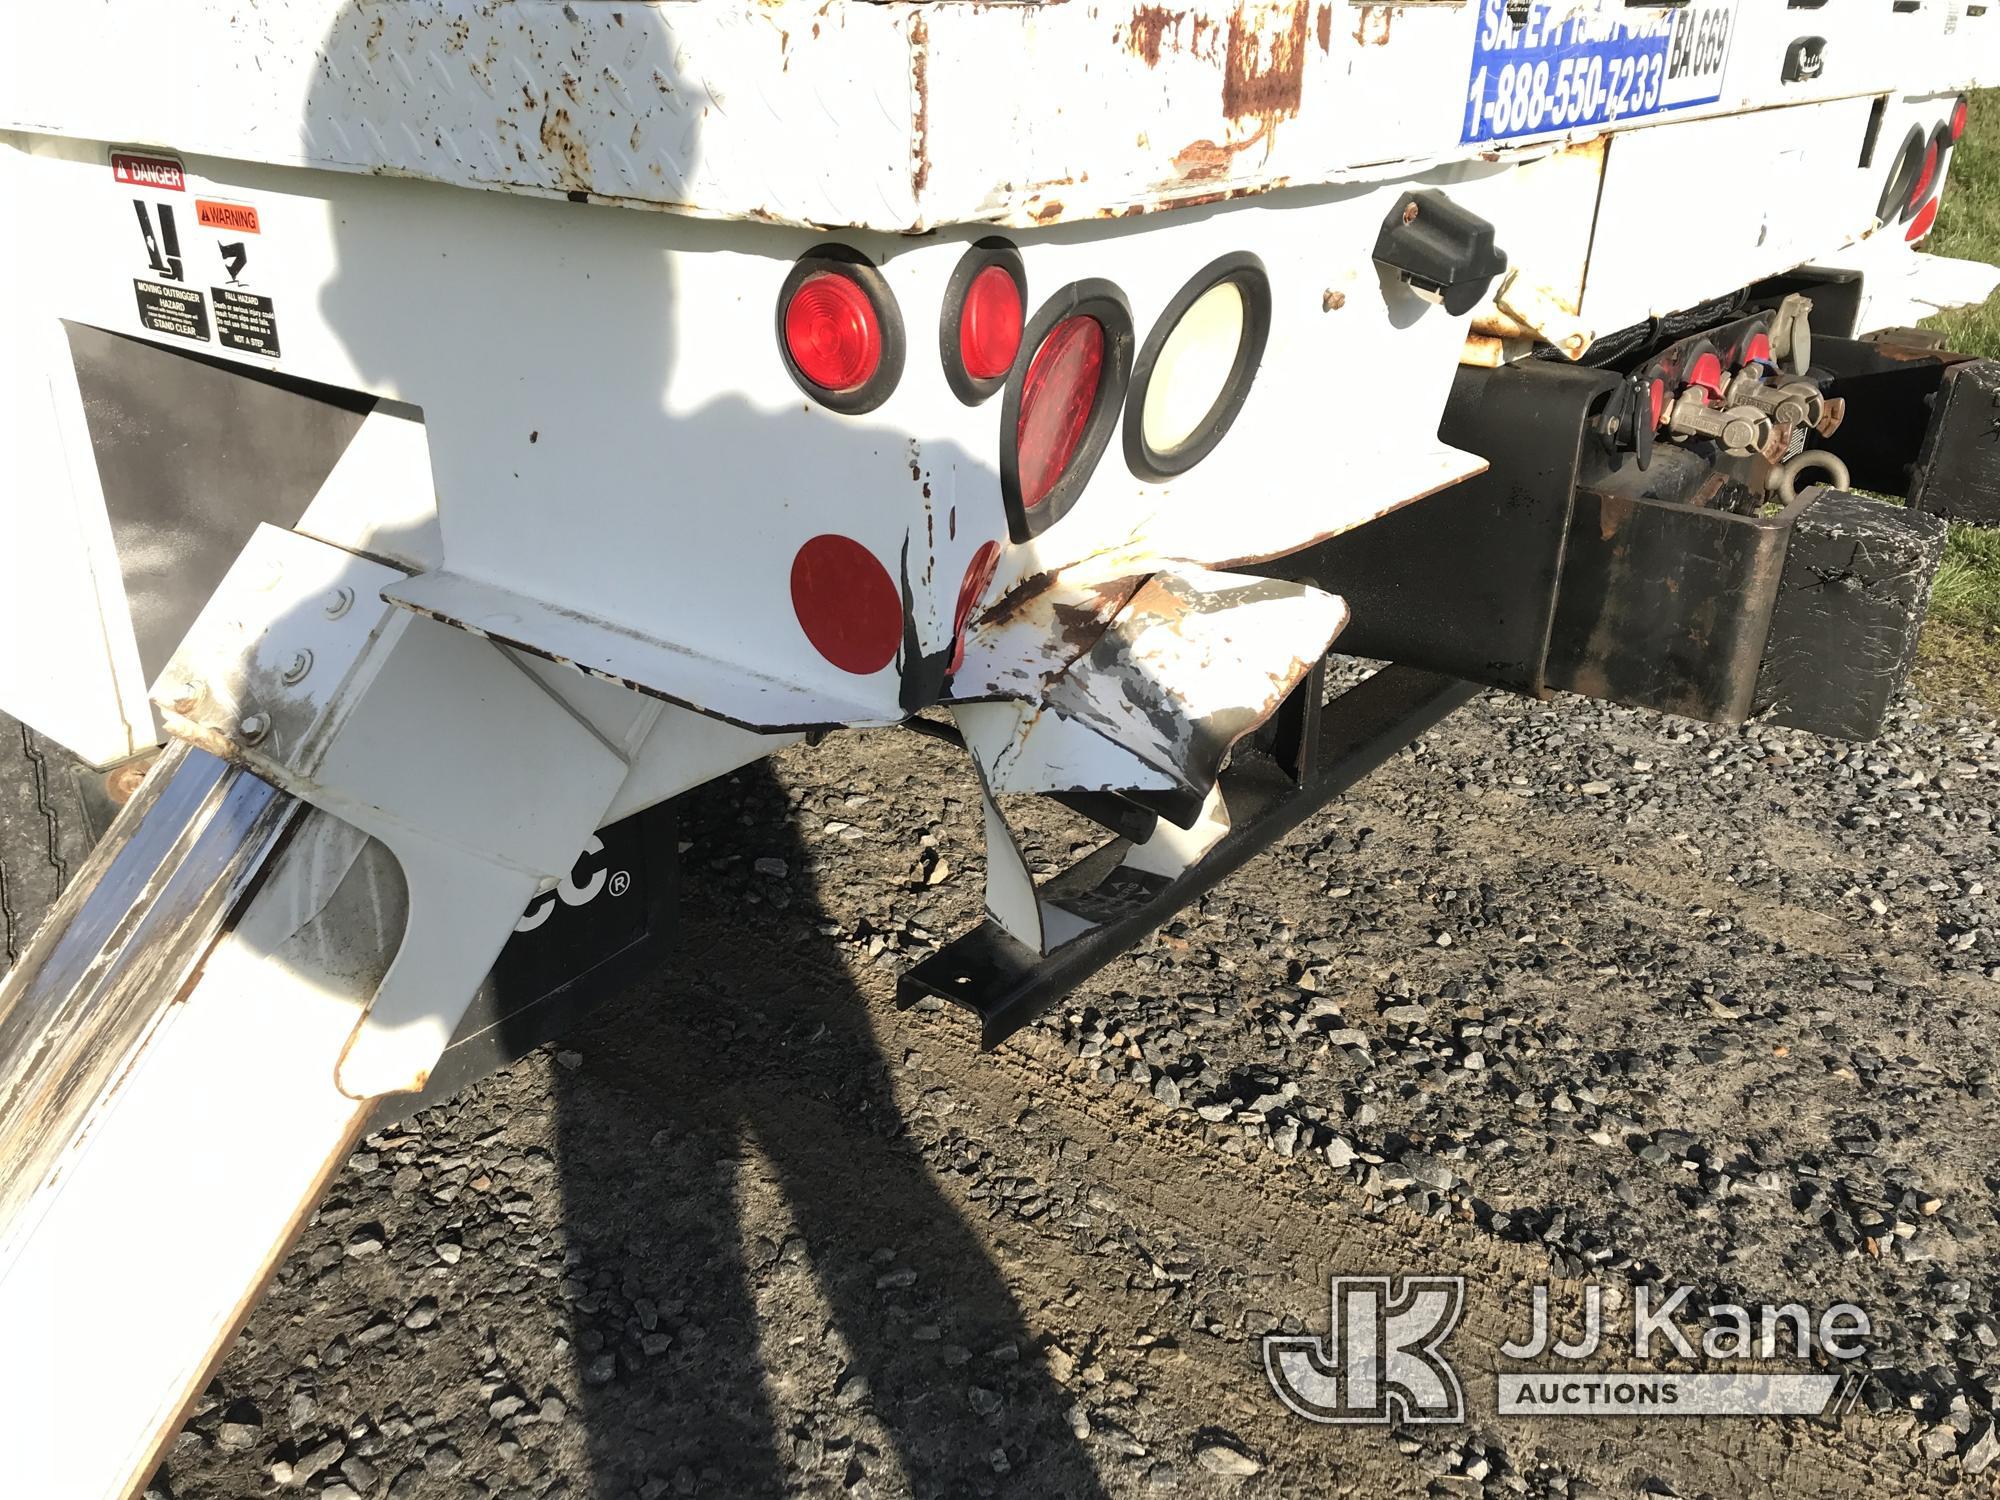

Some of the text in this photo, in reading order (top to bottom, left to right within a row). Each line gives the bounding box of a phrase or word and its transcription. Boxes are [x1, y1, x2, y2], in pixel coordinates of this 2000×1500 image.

[1668, 9, 1696, 79] BA
[1693, 8, 1730, 77] 669
[1470, 53, 1663, 136] 1-888-550-7233
[131, 162, 181, 187] DANGER
[209, 207, 256, 230] WARNING
[138, 281, 200, 303] MOVING OUTRIGGER
[224, 291, 258, 306] FALL HAZARD
[160, 298, 185, 311] HAZARD
[213, 300, 226, 309] Death
[153, 318, 196, 335] STAND CLEAR
[233, 333, 264, 348] NOT A STEP
